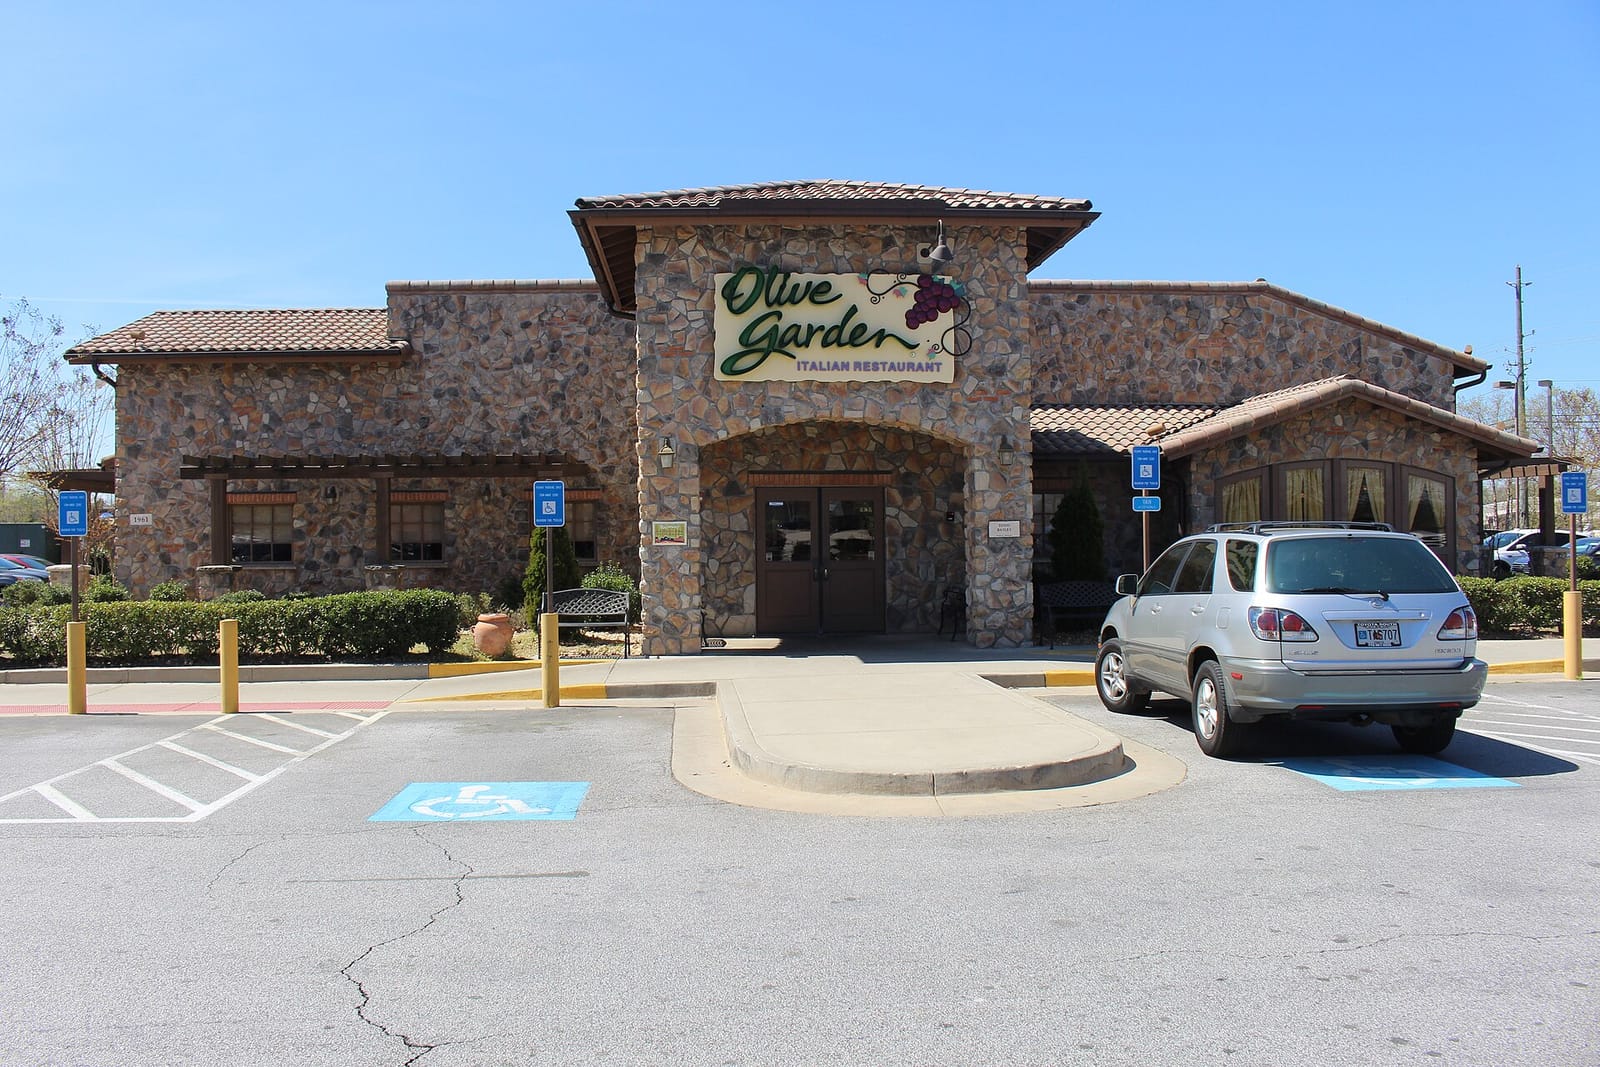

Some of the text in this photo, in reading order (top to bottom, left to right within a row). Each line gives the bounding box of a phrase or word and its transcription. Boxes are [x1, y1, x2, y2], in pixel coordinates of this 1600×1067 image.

[721, 265, 843, 314] Olive
[720, 304, 920, 376] Garden
[797, 361, 943, 372] ITALIAN RESTAURANT
